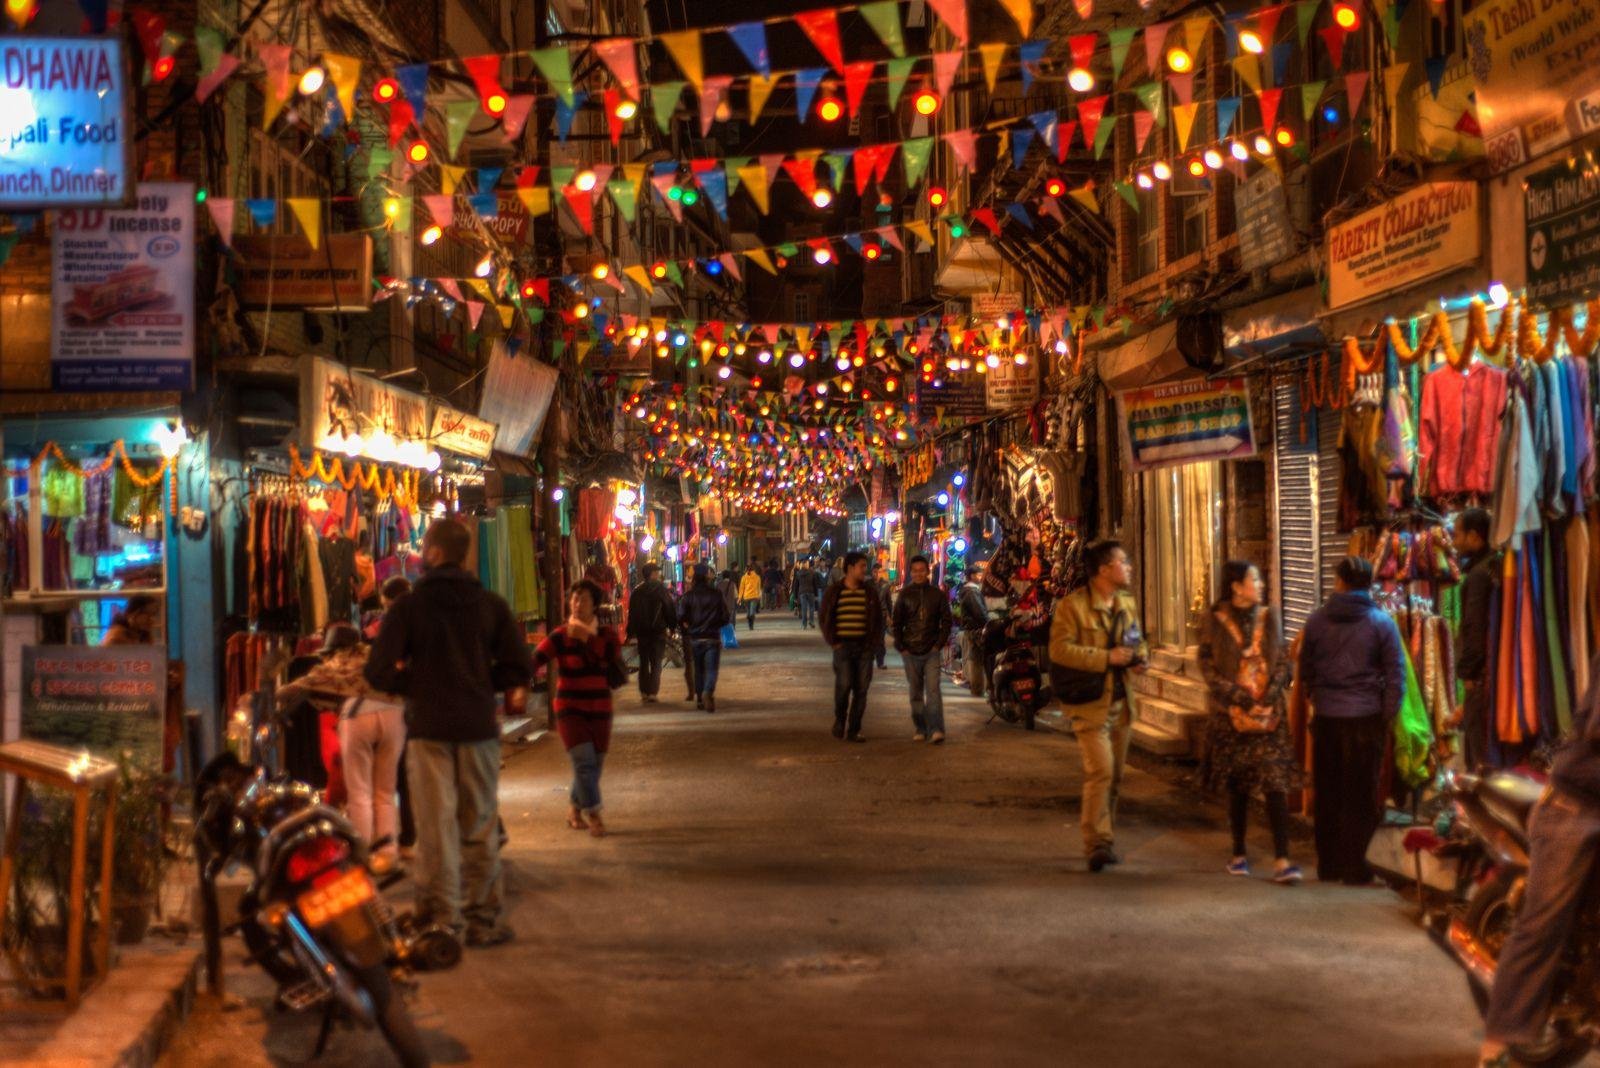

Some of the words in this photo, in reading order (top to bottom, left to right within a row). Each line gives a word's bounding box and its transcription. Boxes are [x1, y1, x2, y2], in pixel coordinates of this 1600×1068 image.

[4, 48, 113, 90] DHAWA
[59, 117, 116, 145] Food
[108, 214, 182, 232] Incense
[1332, 216, 1381, 264] VARIETY
[1383, 183, 1473, 242] COLLECTION
[1199, 414, 1242, 432] SHOP
